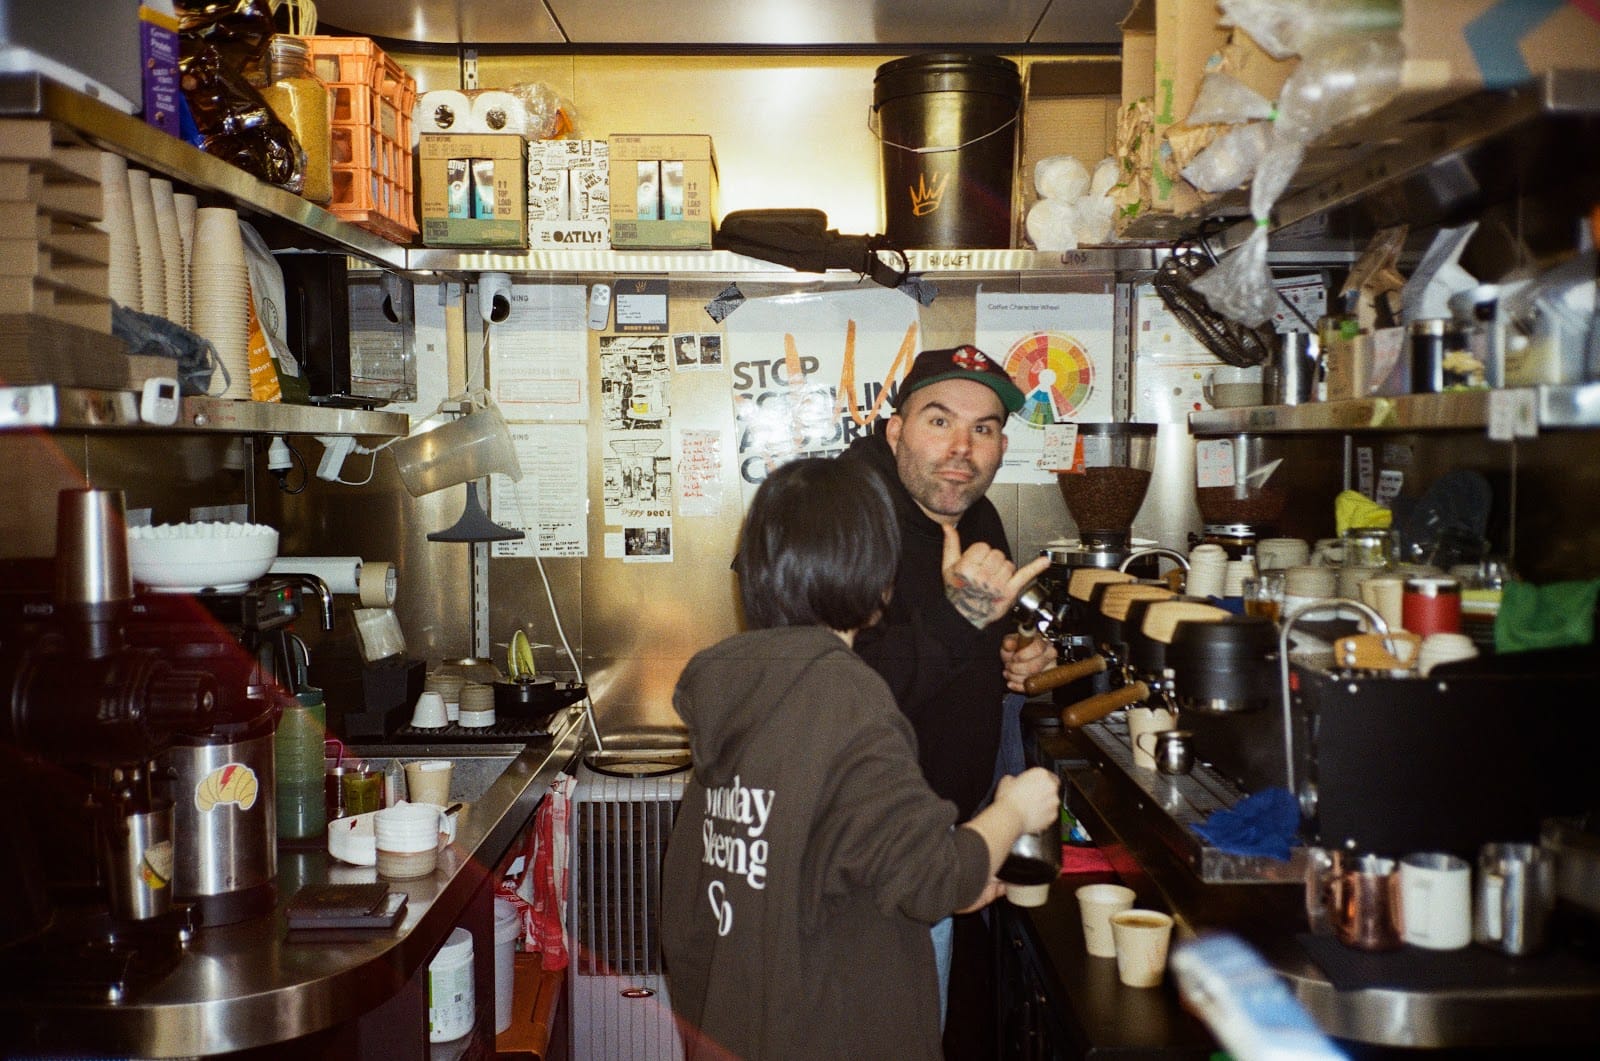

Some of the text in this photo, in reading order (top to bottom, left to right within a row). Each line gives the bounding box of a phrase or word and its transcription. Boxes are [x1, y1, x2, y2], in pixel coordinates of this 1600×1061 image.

[498, 207, 511, 215] ONLY
[553, 231, 602, 243] OATLY!
[928, 255, 972, 266] BUCKET
[1060, 252, 1088, 265] LIDS
[733, 356, 820, 390] STOP
